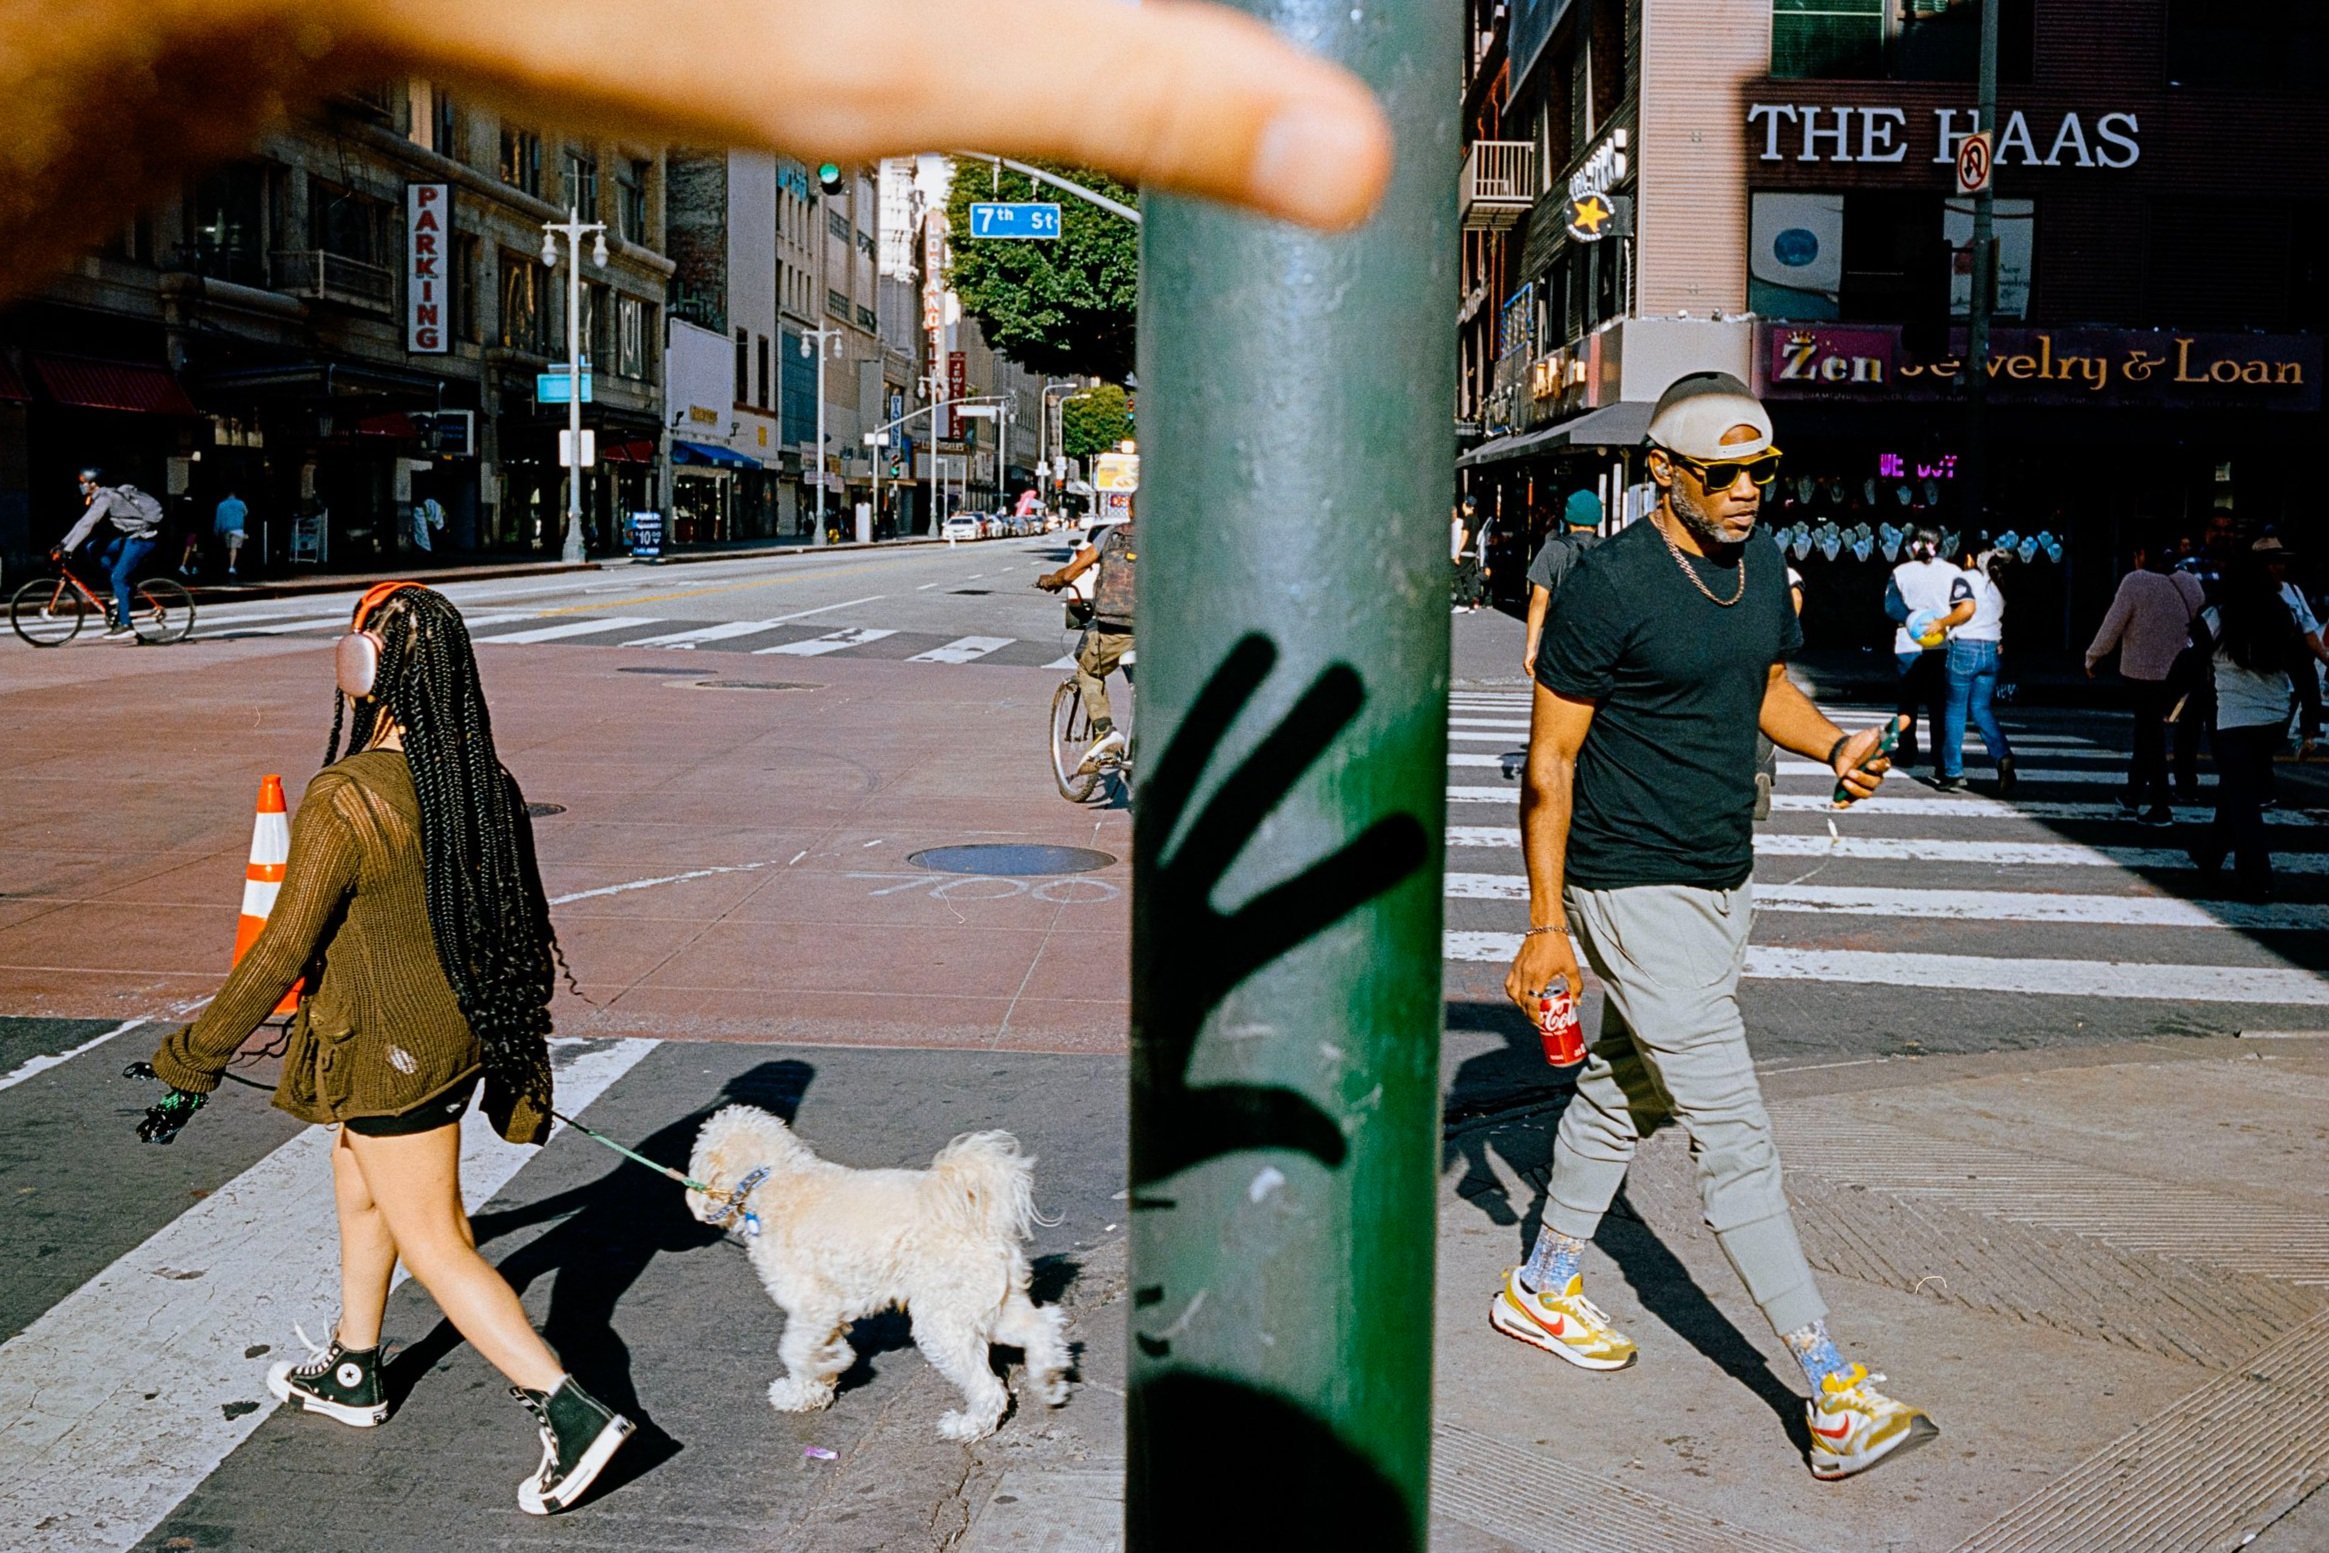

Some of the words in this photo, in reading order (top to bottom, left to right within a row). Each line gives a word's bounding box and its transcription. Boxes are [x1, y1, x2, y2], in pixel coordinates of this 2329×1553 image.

[1747, 103, 1908, 163] THE
[1932, 108, 2141, 169] HAAS
[977, 207, 1014, 233] 7th
[414, 186, 440, 350] PARKING
[1780, 343, 1883, 383] Zen
[2122, 351, 2166, 381] &
[2173, 338, 2304, 384] Loan
